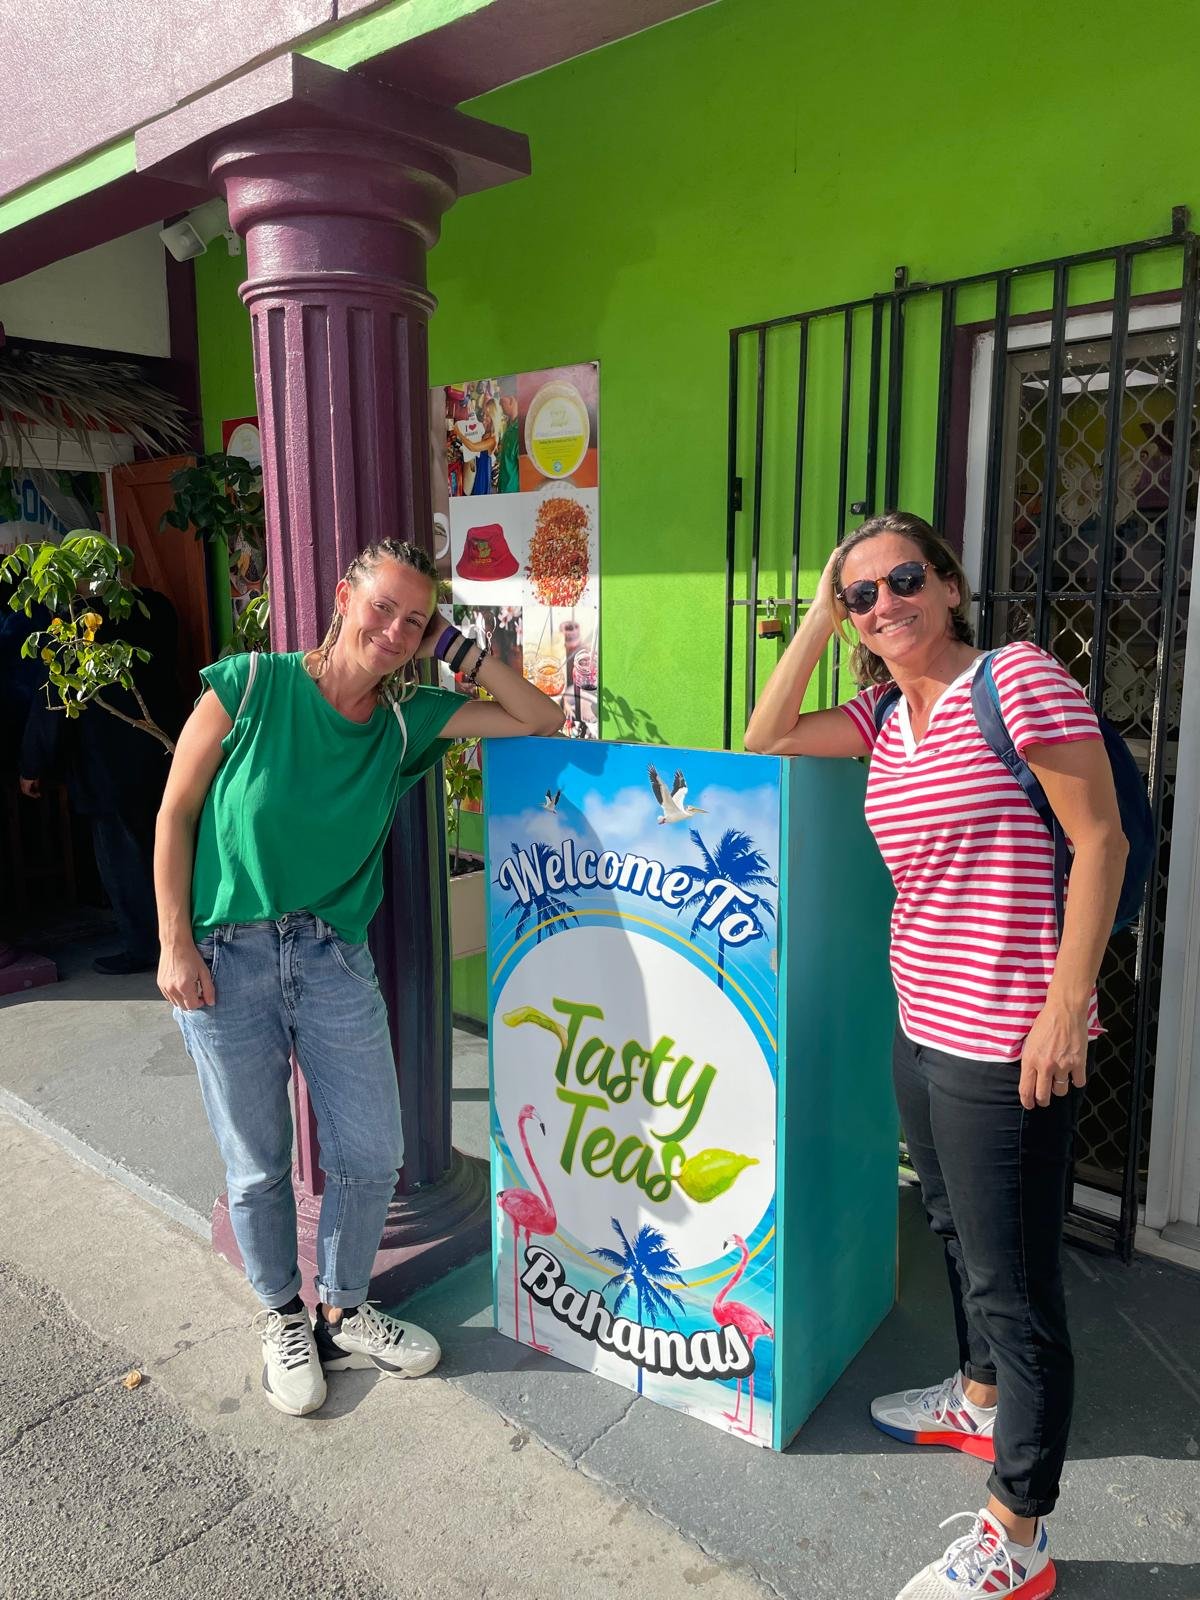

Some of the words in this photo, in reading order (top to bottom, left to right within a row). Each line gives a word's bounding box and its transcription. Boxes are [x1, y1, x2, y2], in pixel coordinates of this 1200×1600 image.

[499, 839, 695, 908] Welcome
[701, 878, 763, 947] To
[552, 997, 718, 1142] Tasty
[556, 1087, 688, 1203] Teas
[520, 1245, 756, 1380] Bahamas
